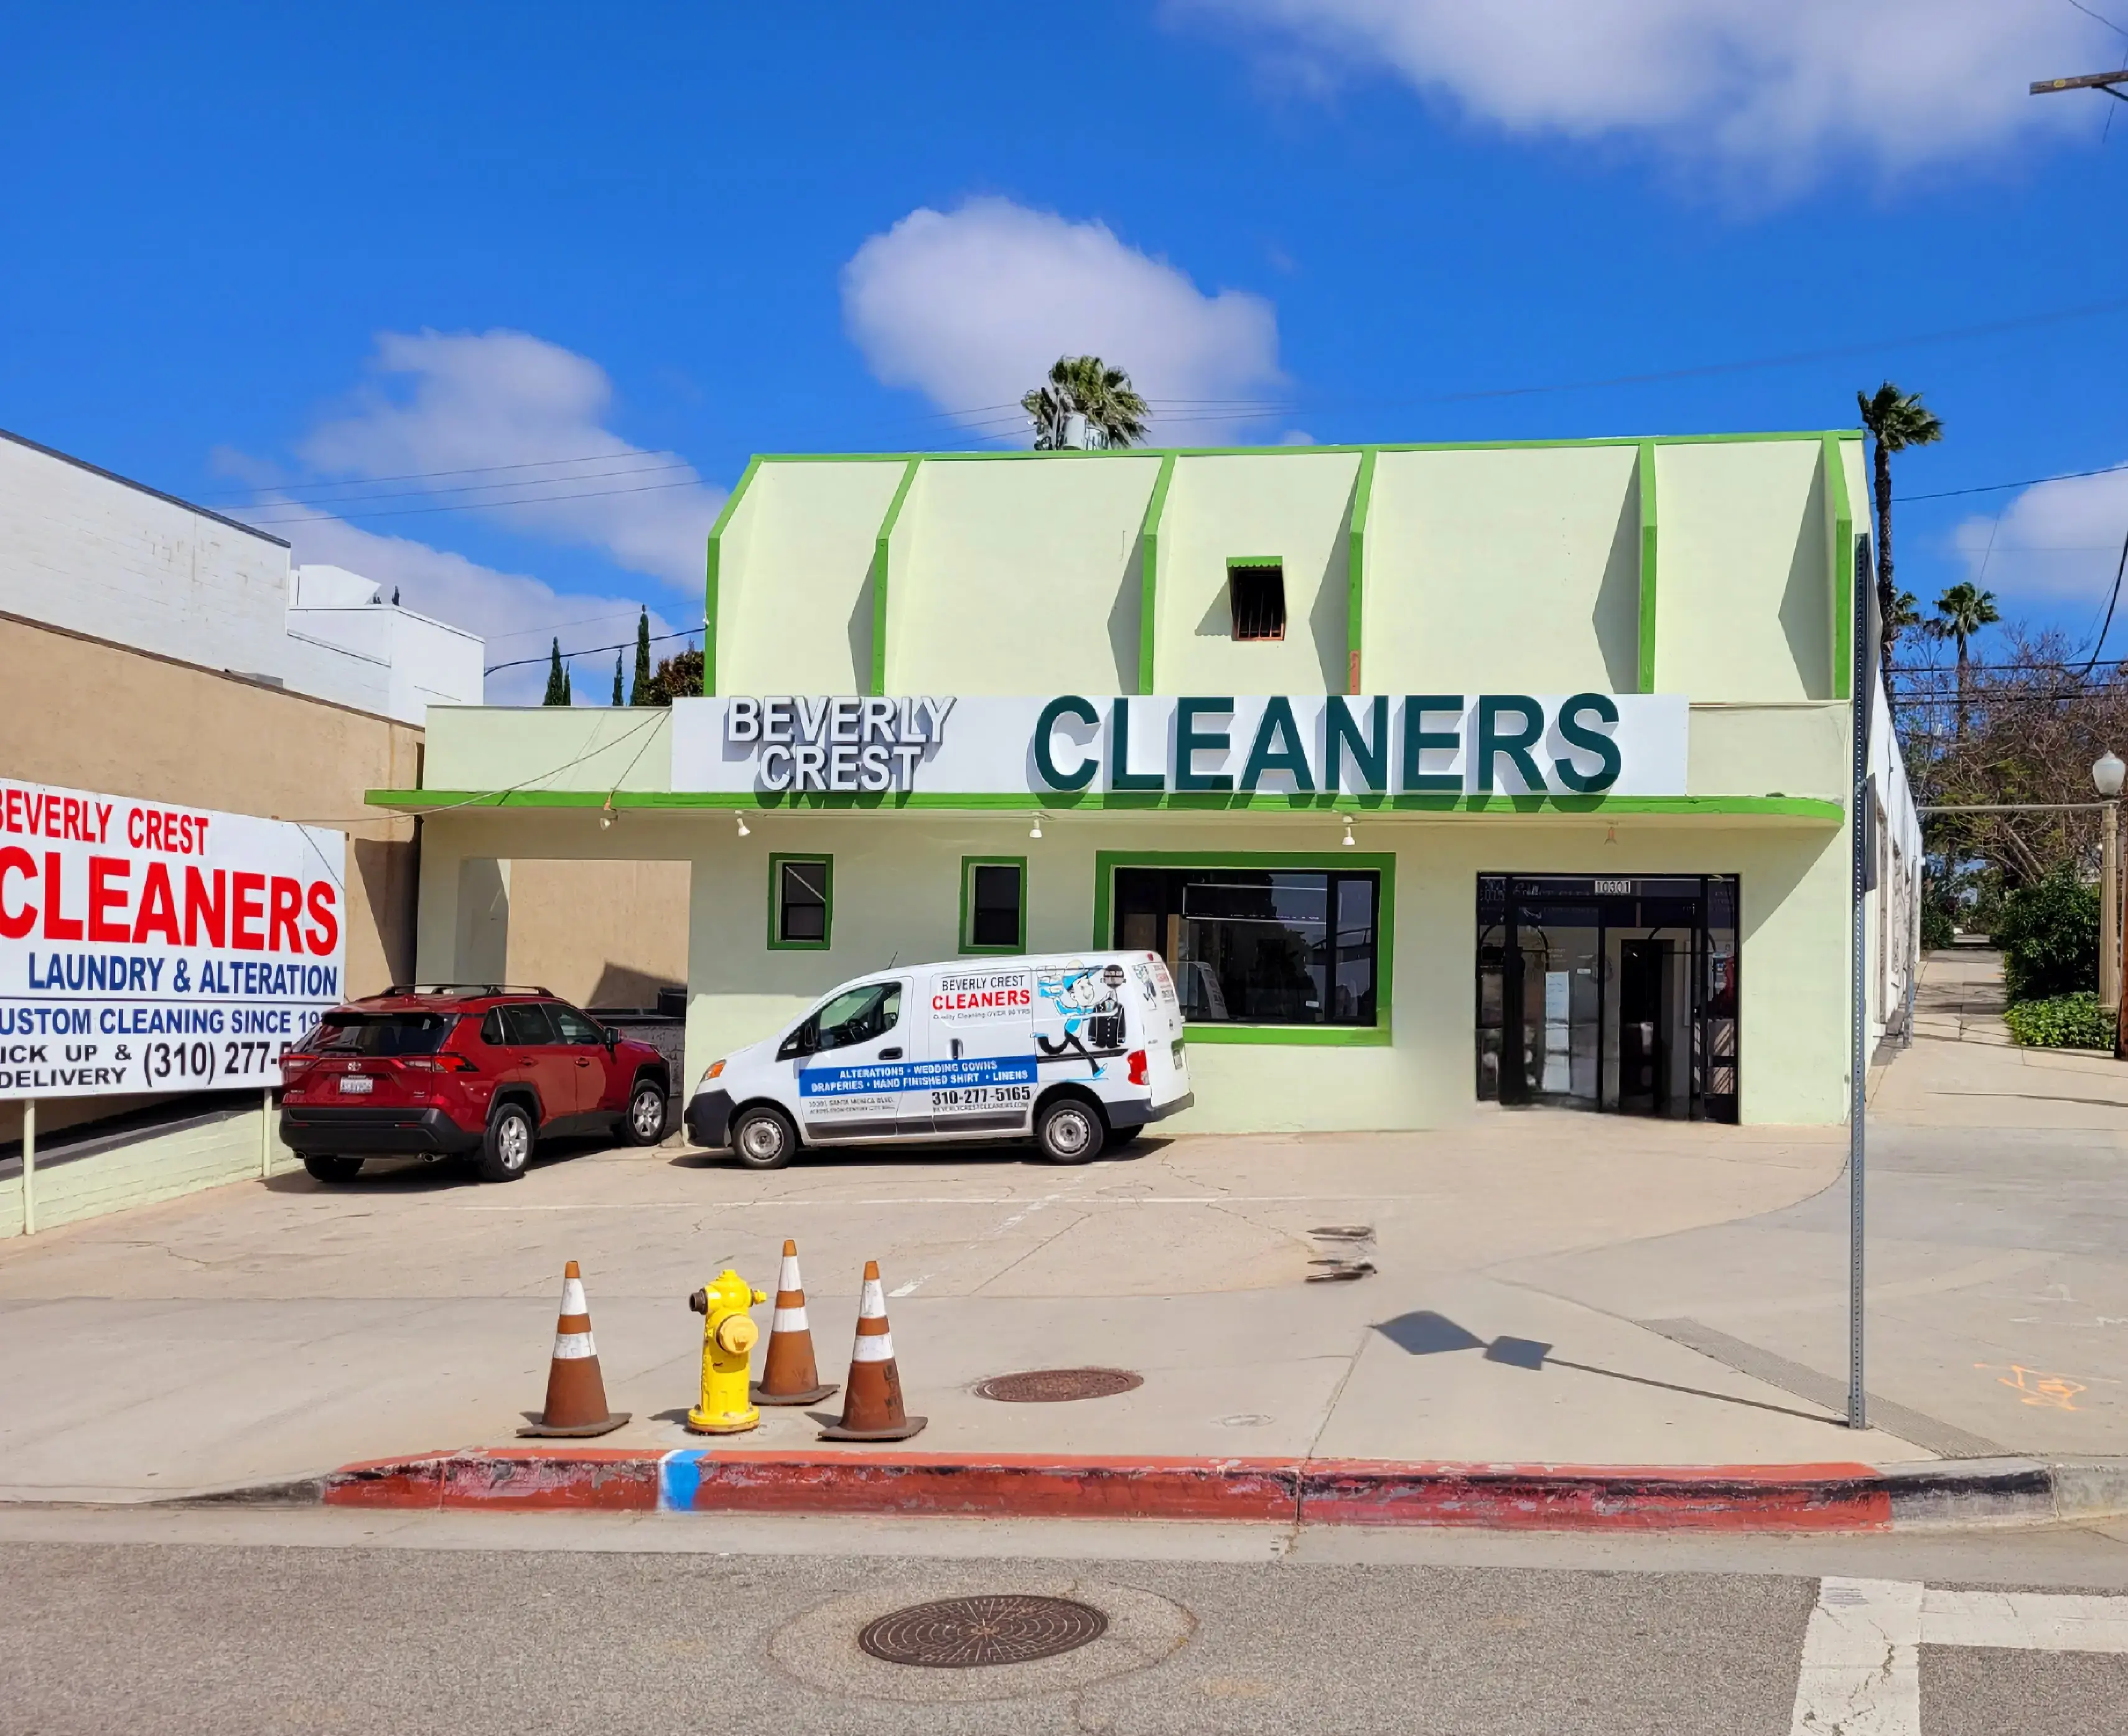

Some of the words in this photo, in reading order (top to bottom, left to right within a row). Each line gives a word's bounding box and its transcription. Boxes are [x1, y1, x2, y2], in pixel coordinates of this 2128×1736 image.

[728, 695, 958, 743] BEVERLY
[1034, 693, 1622, 793] CLEANERS
[760, 744, 926, 791] CREST
[0, 788, 114, 844] EVERLY
[128, 807, 209, 856] CREST
[1597, 881, 1630, 893] 10301
[0, 846, 338, 956] CLEANERS
[29, 951, 164, 992] LAUNDRY
[173, 958, 191, 993] &
[198, 959, 337, 996] ALTERATION
[942, 977, 987, 991] BEVERLY
[991, 975, 1025, 988] CREST
[932, 989, 1030, 1010] CLEANERS
[100, 1007, 224, 1034] CLEANING
[231, 1010, 291, 1034] SINCE
[298, 1010, 322, 1033] 19
[65, 1044, 97, 1063] UP
[114, 1044, 132, 1060] &
[144, 1042, 216, 1088] (310)
[0, 1066, 127, 1089] DELIVERY
[811, 1080, 864, 1093] DRAPERIES
[873, 1078, 900, 1089] HAND
[903, 1074, 948, 1088] FINISHED
[950, 1073, 979, 1085] SHIRT
[993, 1070, 1028, 1081] LINENS
[840, 1066, 904, 1078] ALTERATIONS
[913, 1063, 959, 1075] WEDDING
[962, 1060, 998, 1072] GOWNS
[932, 1086, 1030, 1106] 310-277-5165
